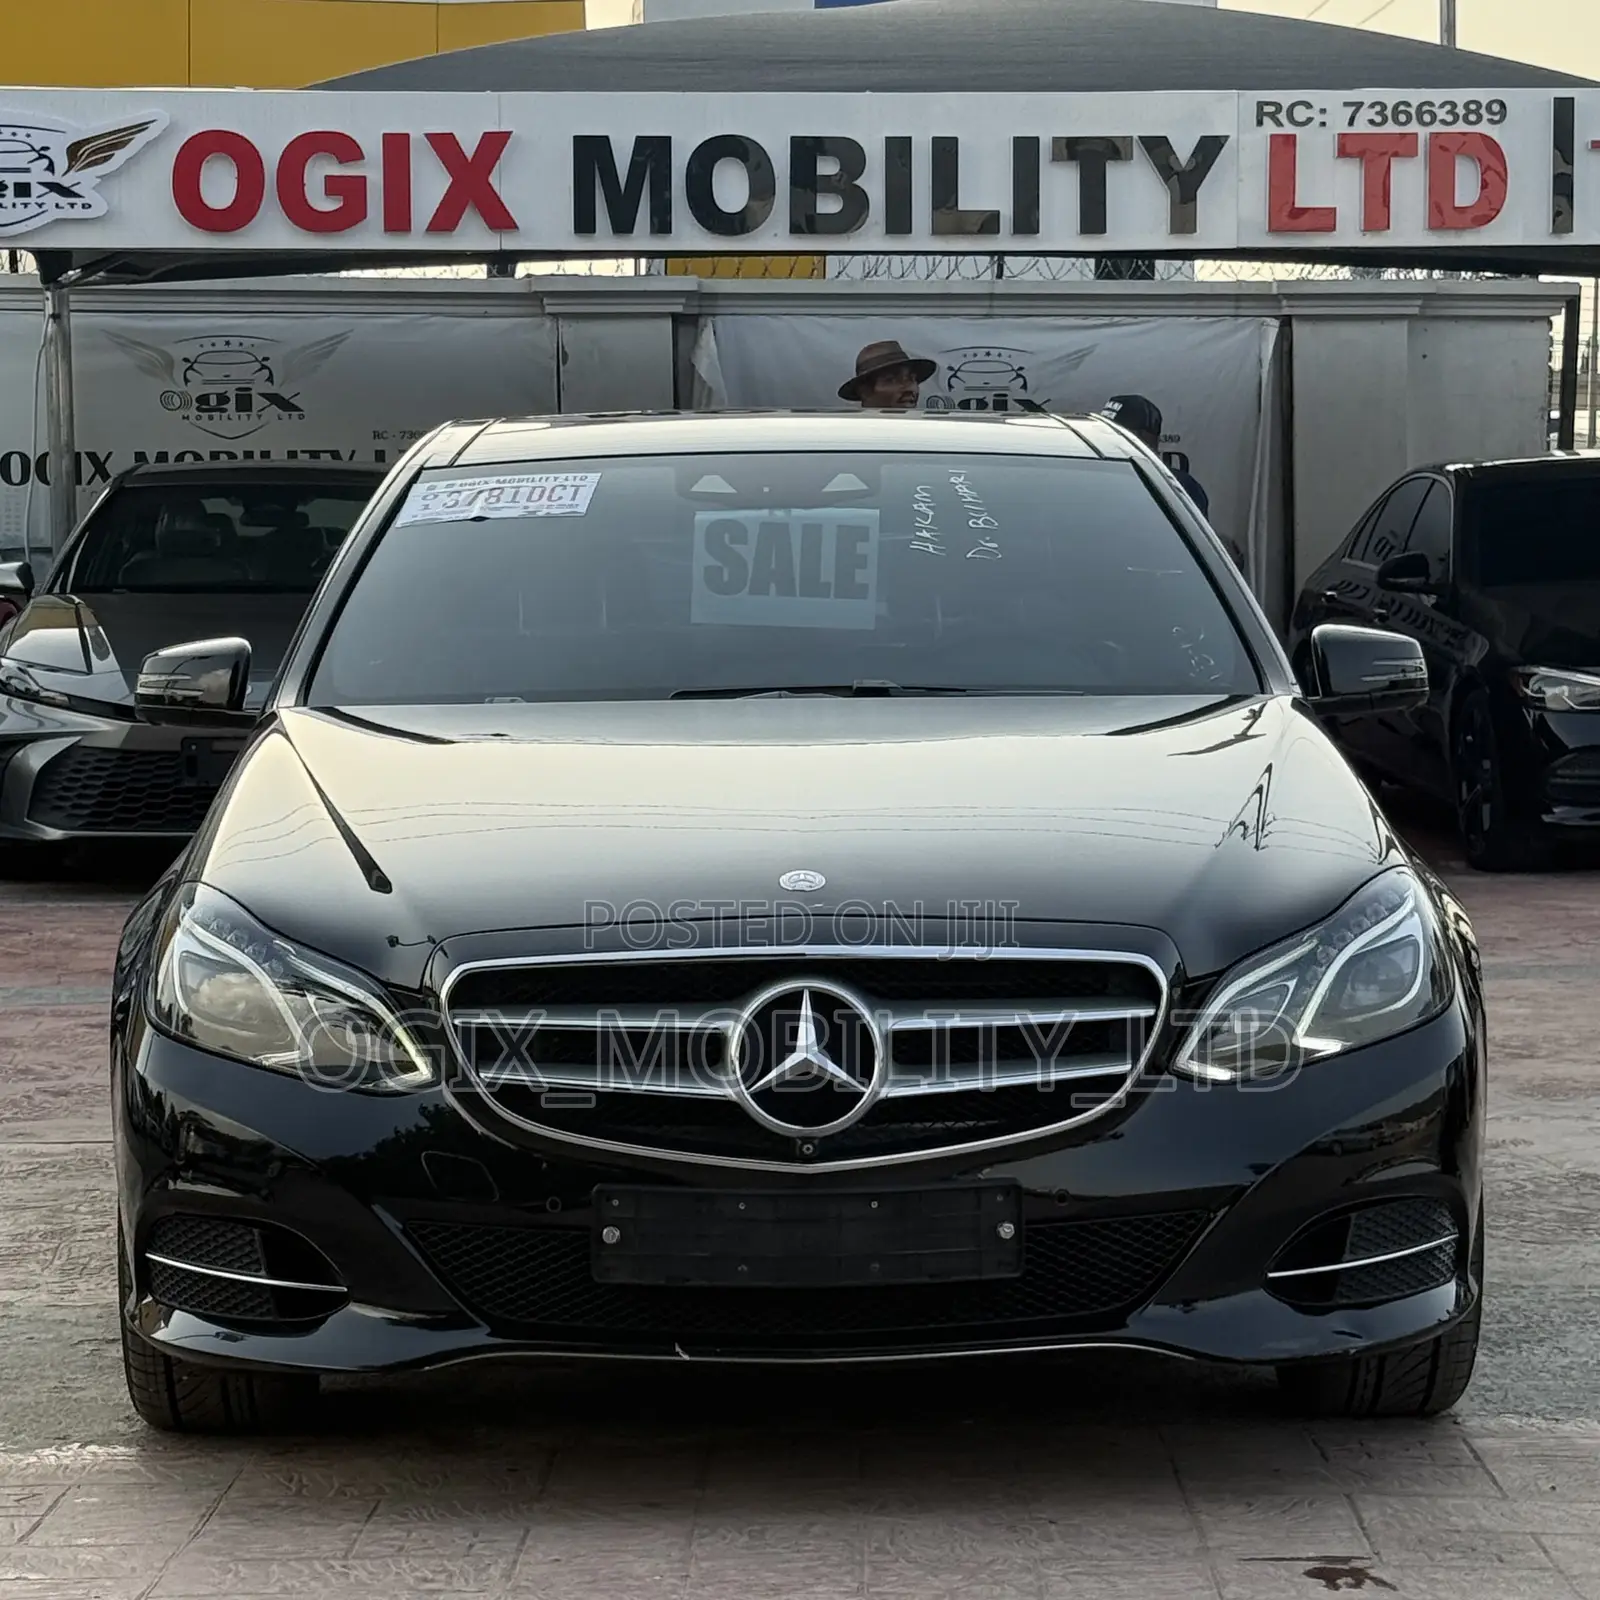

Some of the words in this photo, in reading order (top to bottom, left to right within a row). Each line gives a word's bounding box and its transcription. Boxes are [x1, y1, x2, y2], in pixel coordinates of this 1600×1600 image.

[1255, 100, 1328, 127] RC:
[1342, 99, 1508, 127] 7366389
[171, 129, 519, 234] OGIX
[572, 133, 1230, 236] MOBILITY
[1267, 131, 1509, 233] LTD
[54, 202, 93, 210] LTD
[182, 413, 262, 421] MOBILITY
[277, 413, 305, 421] LTD
[702, 518, 871, 600] SALE
